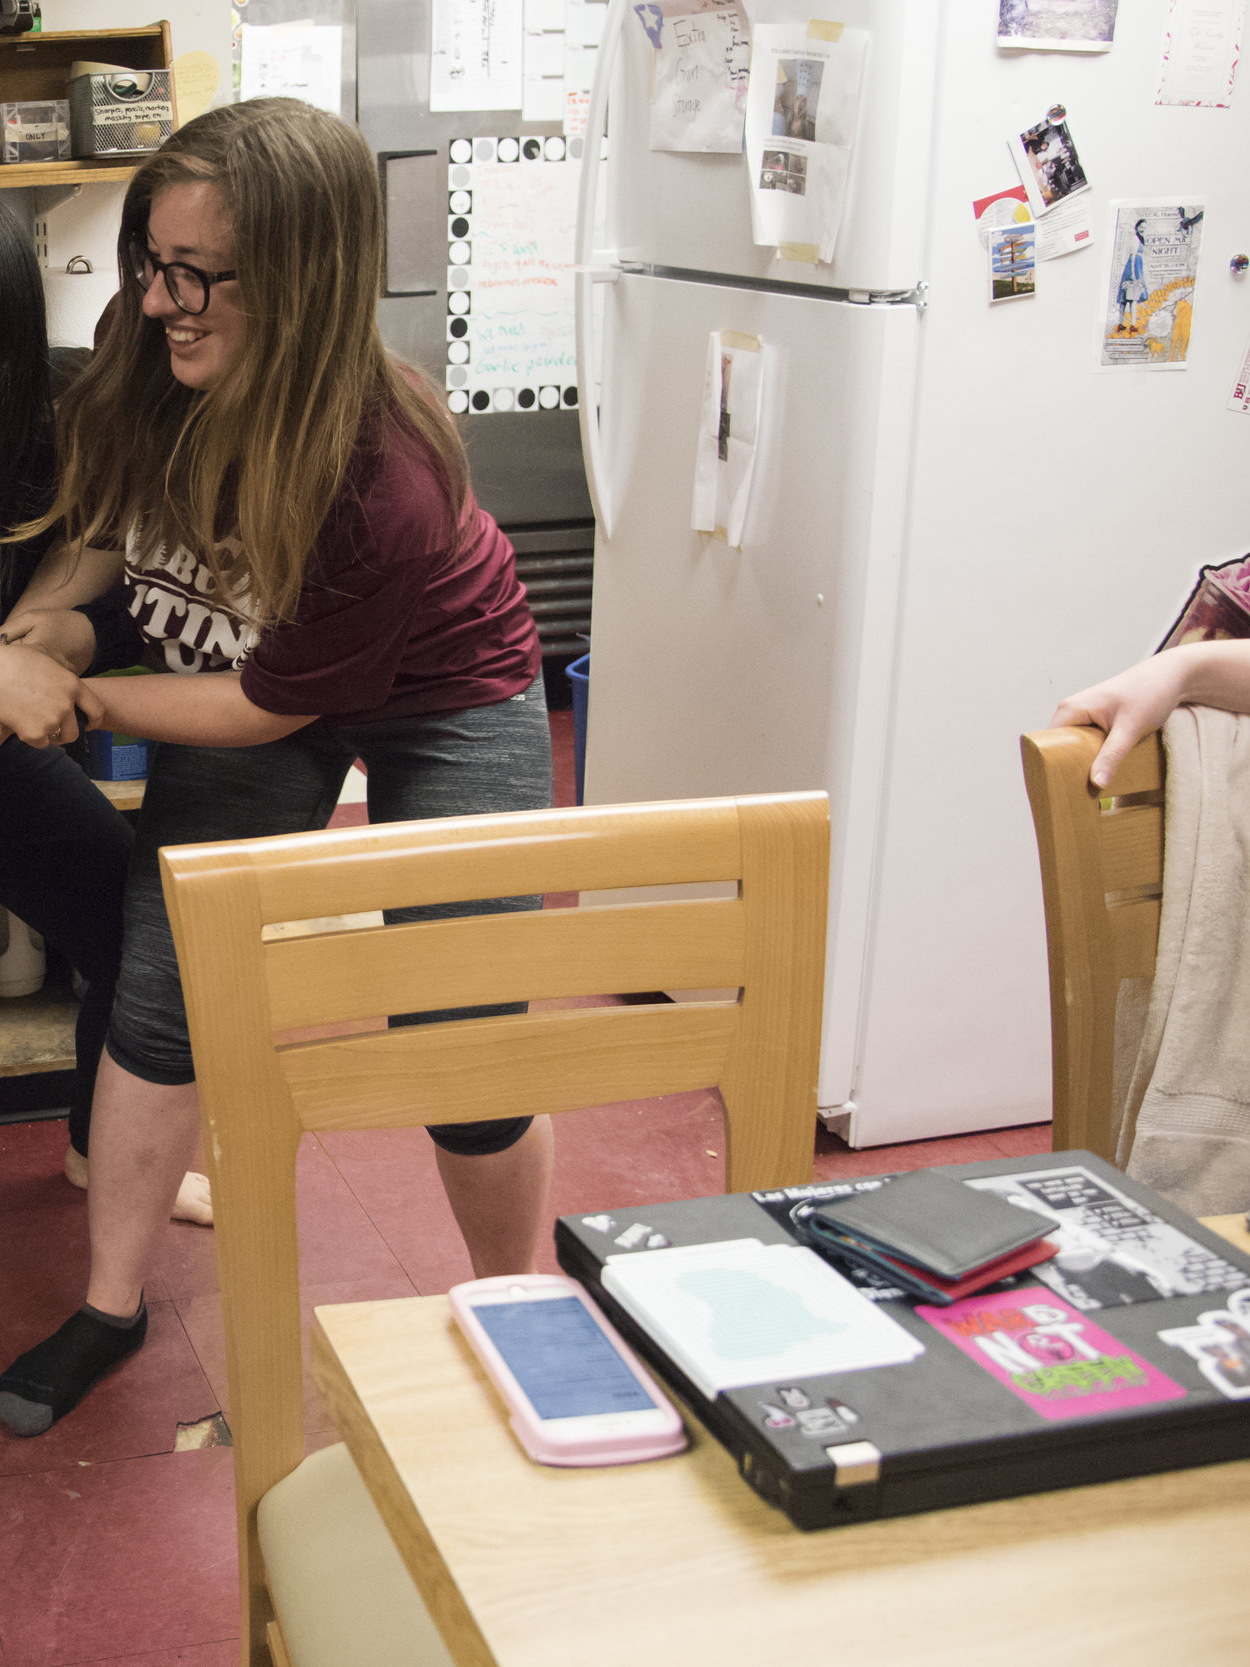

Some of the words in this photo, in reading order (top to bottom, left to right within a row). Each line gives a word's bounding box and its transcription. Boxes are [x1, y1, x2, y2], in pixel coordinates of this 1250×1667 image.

[25, 133, 46, 141] ONLY
[1147, 237, 1170, 245] OPEN
[1152, 247, 1179, 256] NIGHT
[475, 356, 519, 375] Garlic
[973, 1322, 1102, 1374] NOT
